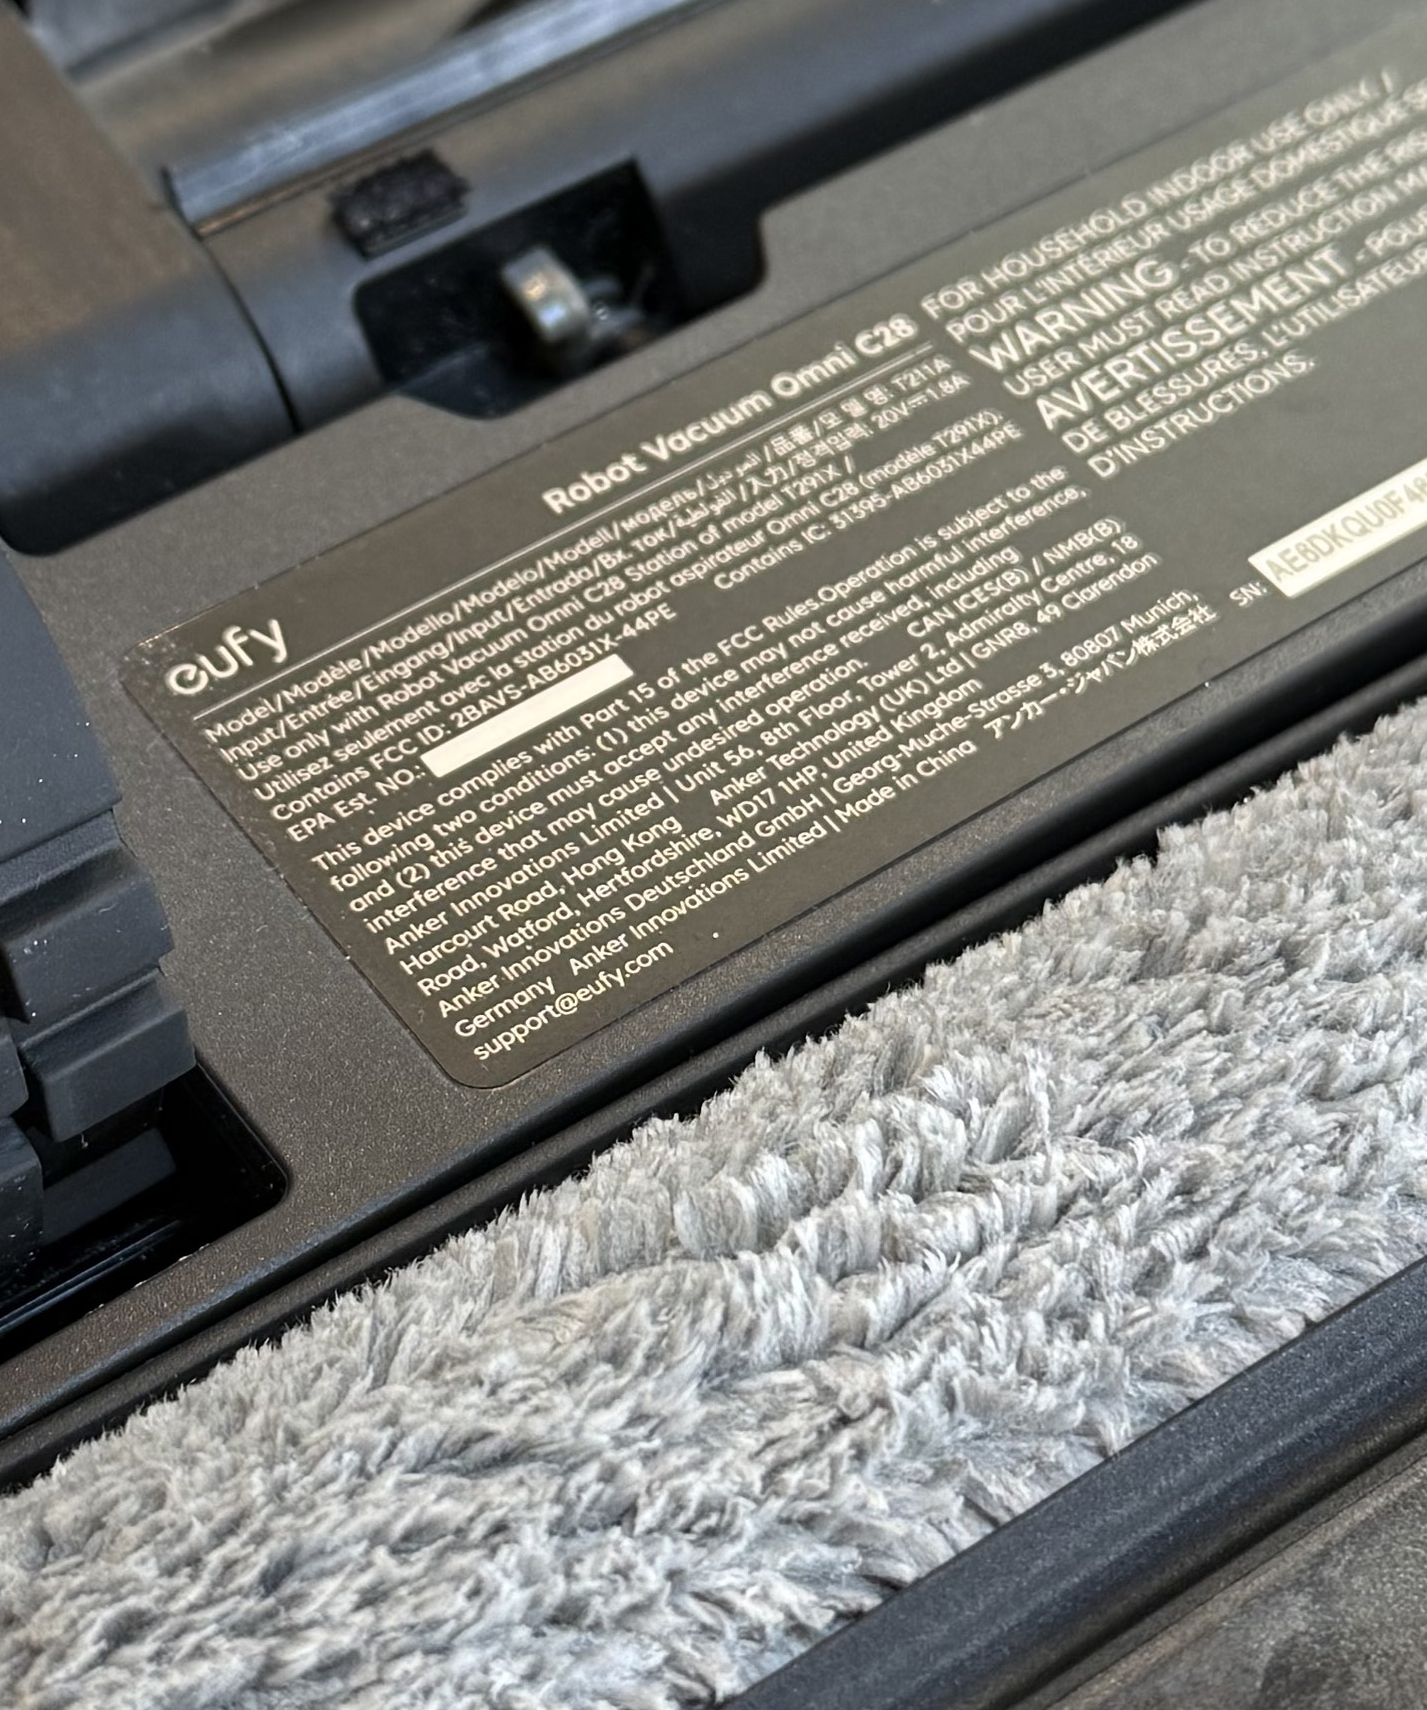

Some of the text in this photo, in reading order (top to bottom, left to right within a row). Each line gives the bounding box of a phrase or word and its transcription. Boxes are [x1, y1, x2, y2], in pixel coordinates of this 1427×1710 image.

[920, 279, 985, 320] FOR
[980, 197, 1149, 289] HOUSEHOLD
[944, 294, 1028, 343] POUR
[967, 257, 1176, 371] WARNING
[1186, 233, 1233, 264] TO
[890, 357, 952, 391] T211A
[1002, 349, 1083, 396] USER
[1076, 305, 1155, 359] MUST
[1153, 272, 1231, 320] READ
[1035, 243, 1347, 431] AVERTISSEMENT
[541, 316, 917, 514] Robot Vacuum Omni C28
[1060, 417, 1109, 454] DE
[1086, 352, 1315, 478] D'INSTRUCTIONS.
[712, 538, 804, 590] Contains
[799, 523, 832, 545] IC:
[905, 517, 1122, 638] CAN ICES(B) NMB(B)
[1228, 580, 1268, 607] SN:
[164, 618, 288, 696] eufy
[236, 462, 842, 781] Use only with Robot Vacuum Omni C28 Station of model T291X
[253, 755, 334, 801] Utilisez
[331, 699, 441, 762] seulement
[438, 673, 491, 707] avec
[486, 661, 514, 681] la
[511, 625, 585, 669] station
[583, 609, 615, 632] du
[612, 579, 672, 617] robot
[668, 528, 766, 587] aspirateur
[764, 499, 822, 535] Omni
[818, 480, 860, 508] C28
[857, 443, 937, 490] (modèle
[309, 466, 1066, 871] This device complies with Part 15 of the FCC Rules.Operation is subject to the
[708, 553, 1158, 807] Anker Technology (UK) Ltd GNR8, 49 Clarendon
[329, 486, 1087, 892] following two conditions: (1) this device may not cause harmful interference,
[348, 545, 1021, 912] and (2) this device must accept any interference received, including
[384, 534, 1139, 955] Anker Innovations Limited Unit 56, 8th Floor, Tower 2, Admiralty Centre, 18
[269, 765, 371, 821] Contains
[367, 736, 419, 771] FCC
[415, 722, 452, 746] ID:
[285, 811, 336, 842] EPA
[331, 791, 378, 818] Est.
[437, 589, 1199, 1019] Anker Innovations Deutschland GmbH Georg-Muche-Strasse 3, 80807 Munich,
[398, 815, 683, 975] Harcourt Road, Hong Kong
[568, 739, 978, 976] Anker Innovations Limited Made in China
[453, 975, 556, 1037] Germany
[472, 941, 674, 1061] support@eufy.com
